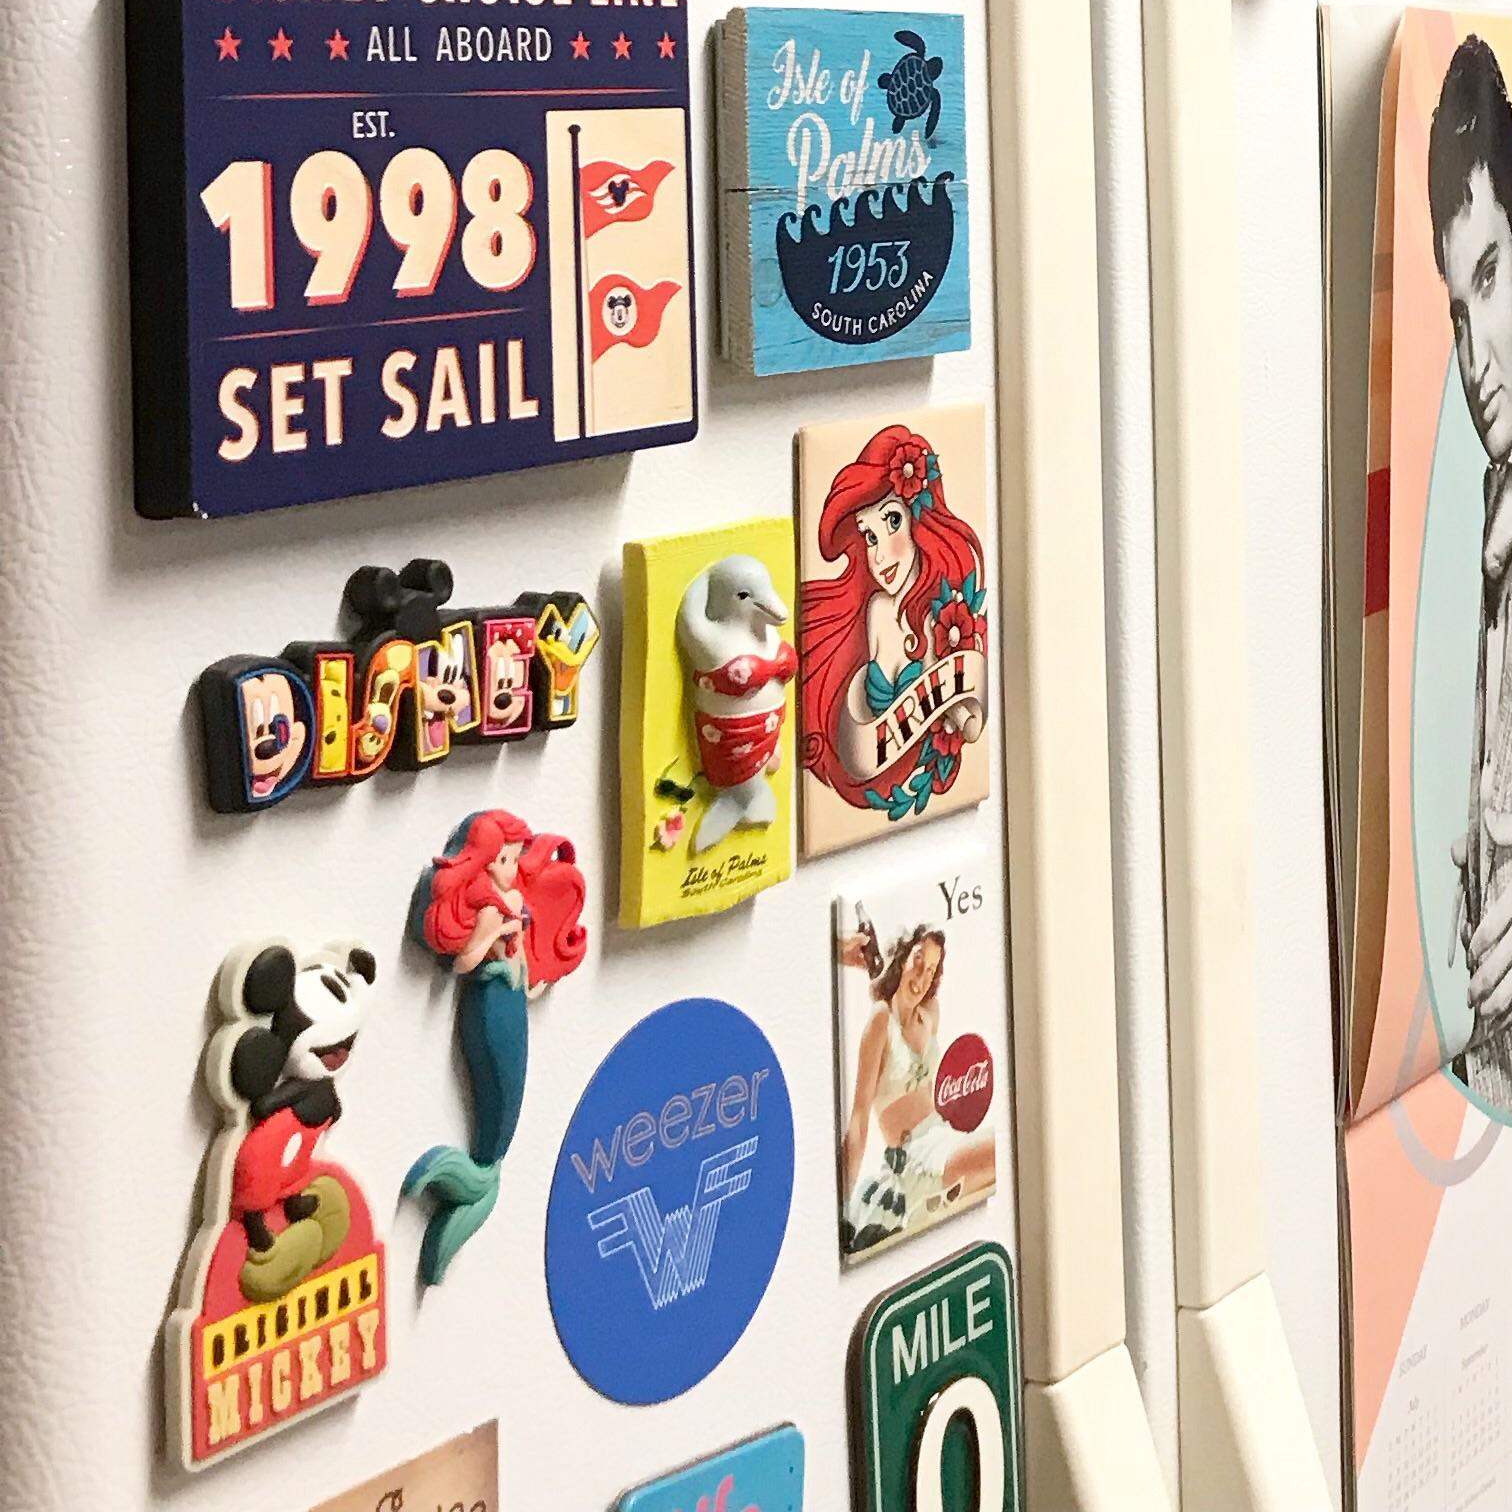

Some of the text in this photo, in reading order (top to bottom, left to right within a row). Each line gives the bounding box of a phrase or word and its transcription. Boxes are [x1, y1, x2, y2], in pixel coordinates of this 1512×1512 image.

[366, 25, 553, 63] ALL ABOARD
[766, 38, 872, 126] Isle of
[352, 111, 396, 139] EST.
[787, 112, 932, 216] Palms
[200, 147, 537, 312] 1998
[827, 239, 912, 295] 1953
[811, 270, 935, 337] SOUTH CAROLINA
[217, 338, 540, 463] SET SAIL
[230, 600, 602, 806] DISNEY
[874, 654, 977, 768] ARIEL
[680, 867, 709, 889] Isle
[938, 875, 984, 922] Yes
[570, 1067, 770, 1194] weezer
[207, 1308, 381, 1446] MICKEY
[890, 1273, 994, 1385] MILE
